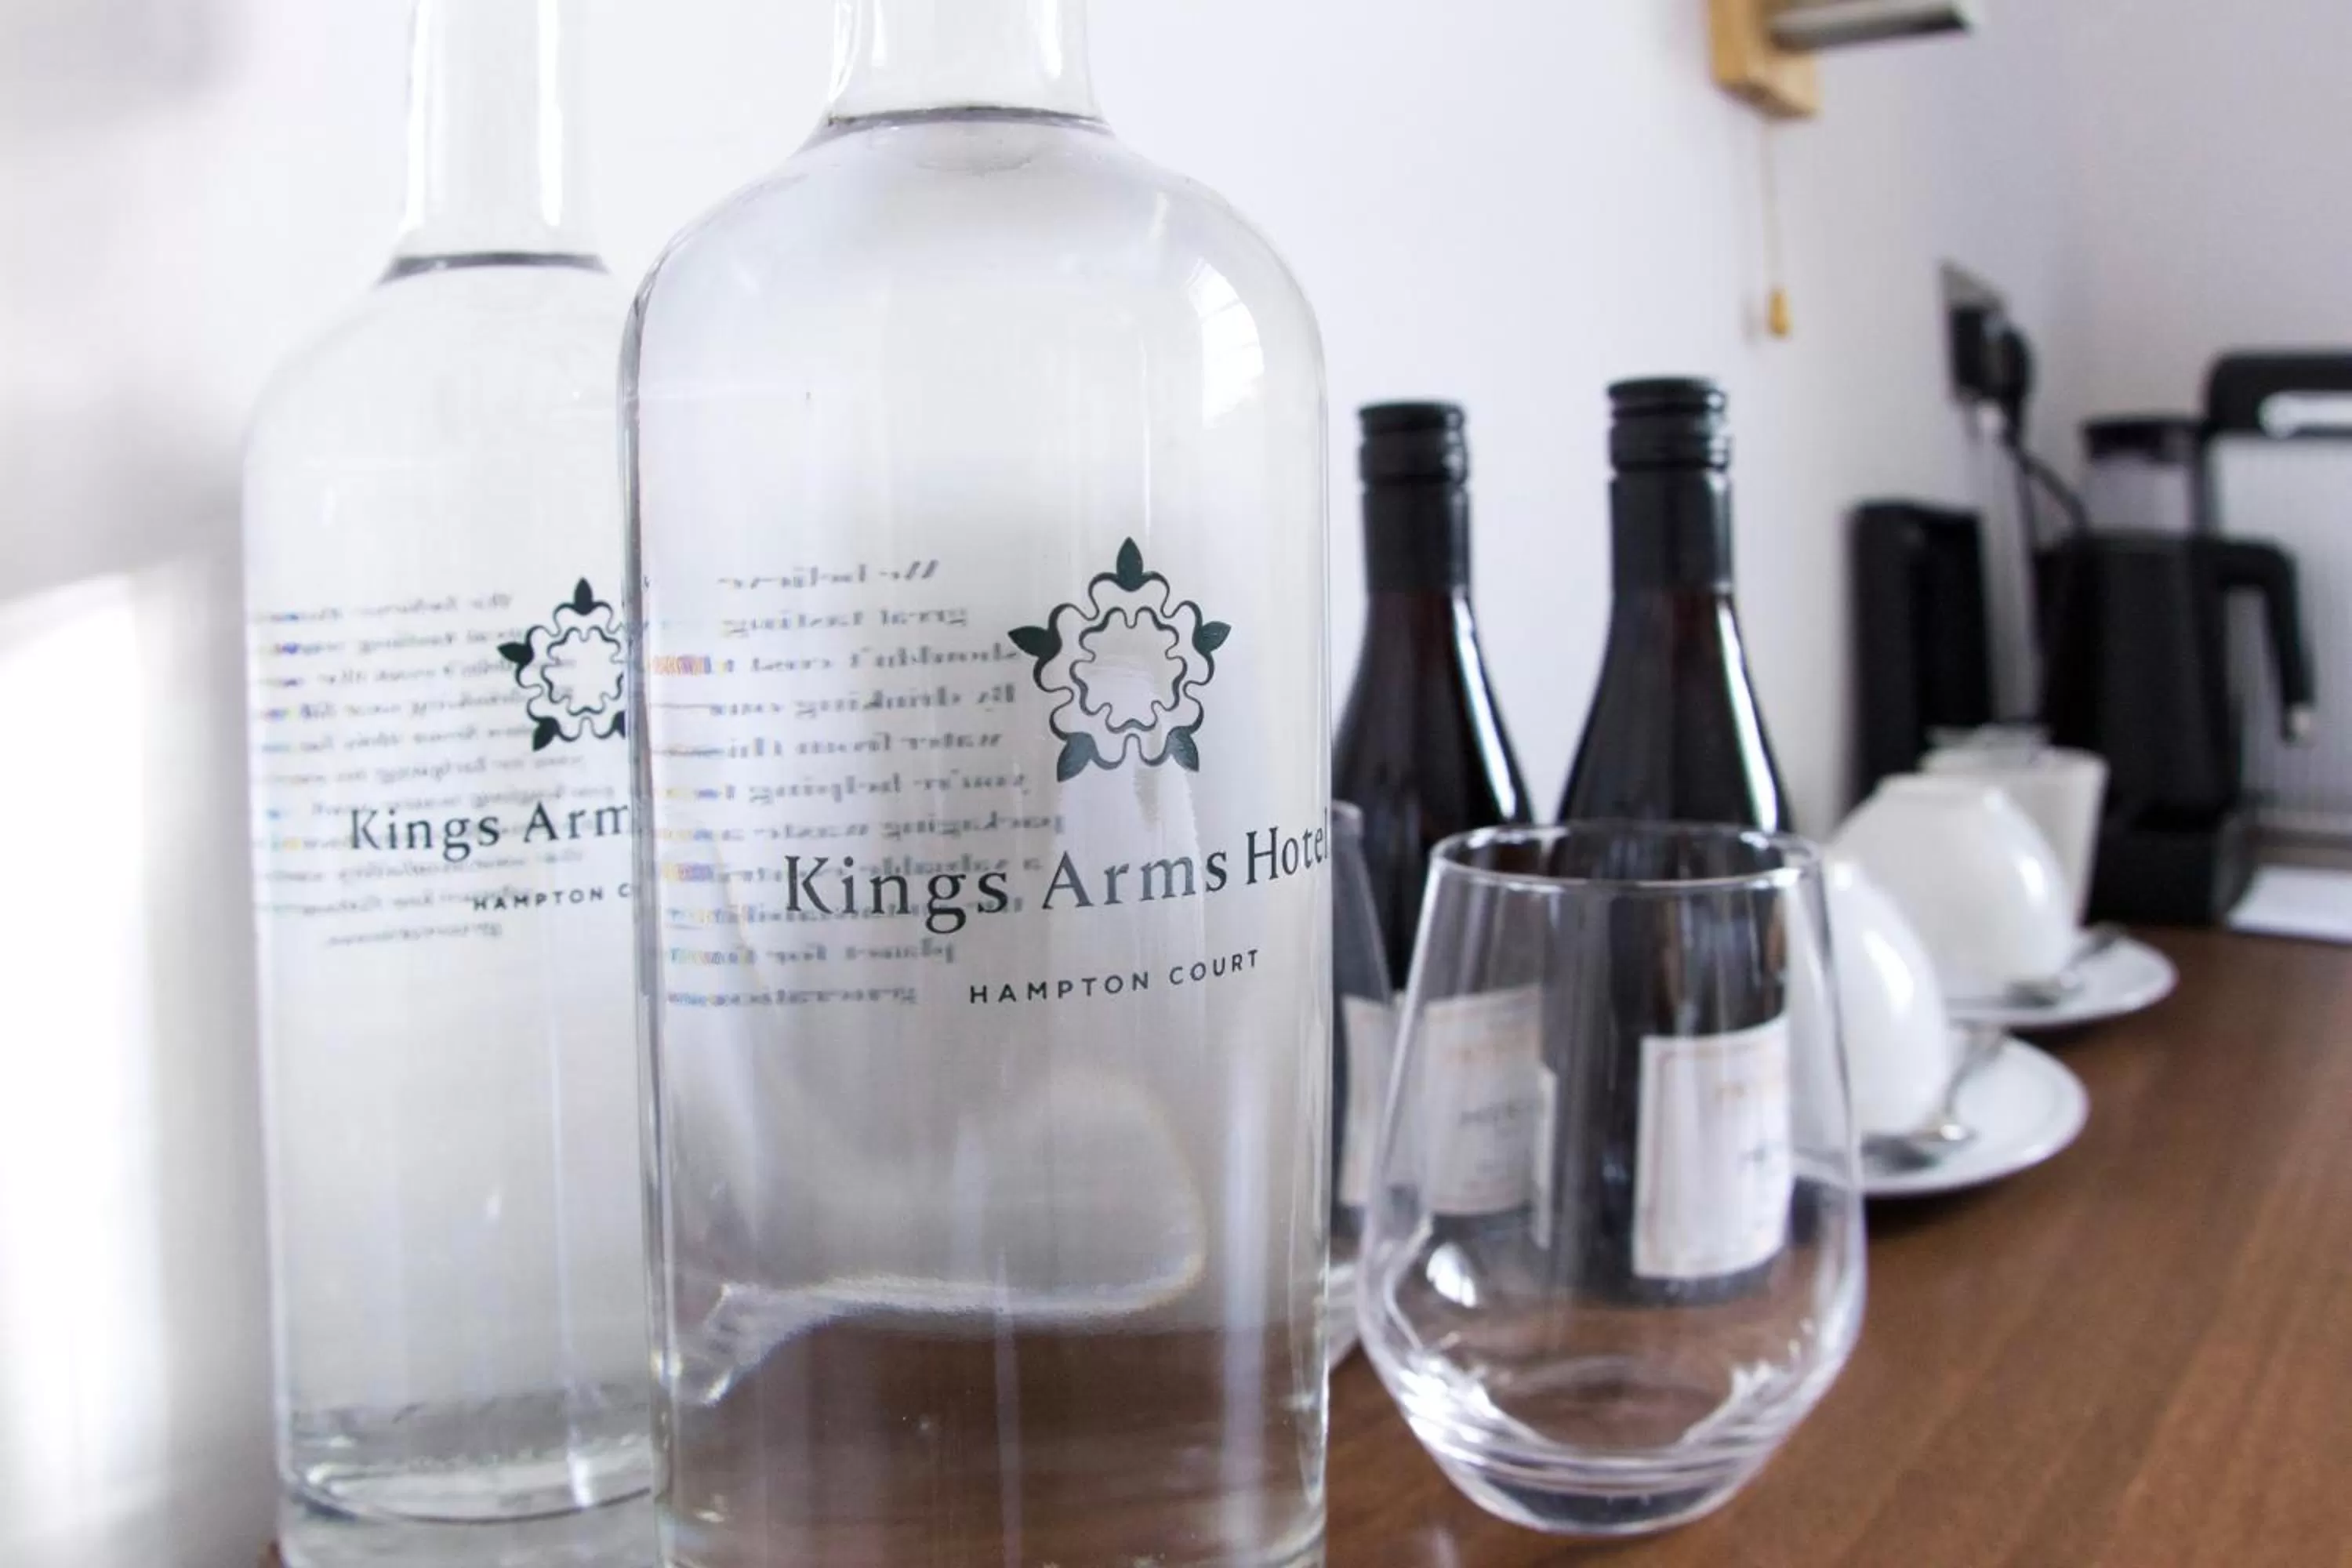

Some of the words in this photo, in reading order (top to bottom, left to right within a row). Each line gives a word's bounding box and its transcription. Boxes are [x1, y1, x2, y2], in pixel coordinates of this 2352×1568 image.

[350, 808, 502, 862] Kings
[524, 800, 628, 844] Arm
[472, 886, 604, 911] HAMPTON
[784, 855, 1008, 935] Kings
[1043, 850, 1228, 912] Arms
[1245, 806, 1327, 885] Hotel
[970, 972, 1150, 1004] HAMPTON
[1169, 949, 1260, 984] COURT
